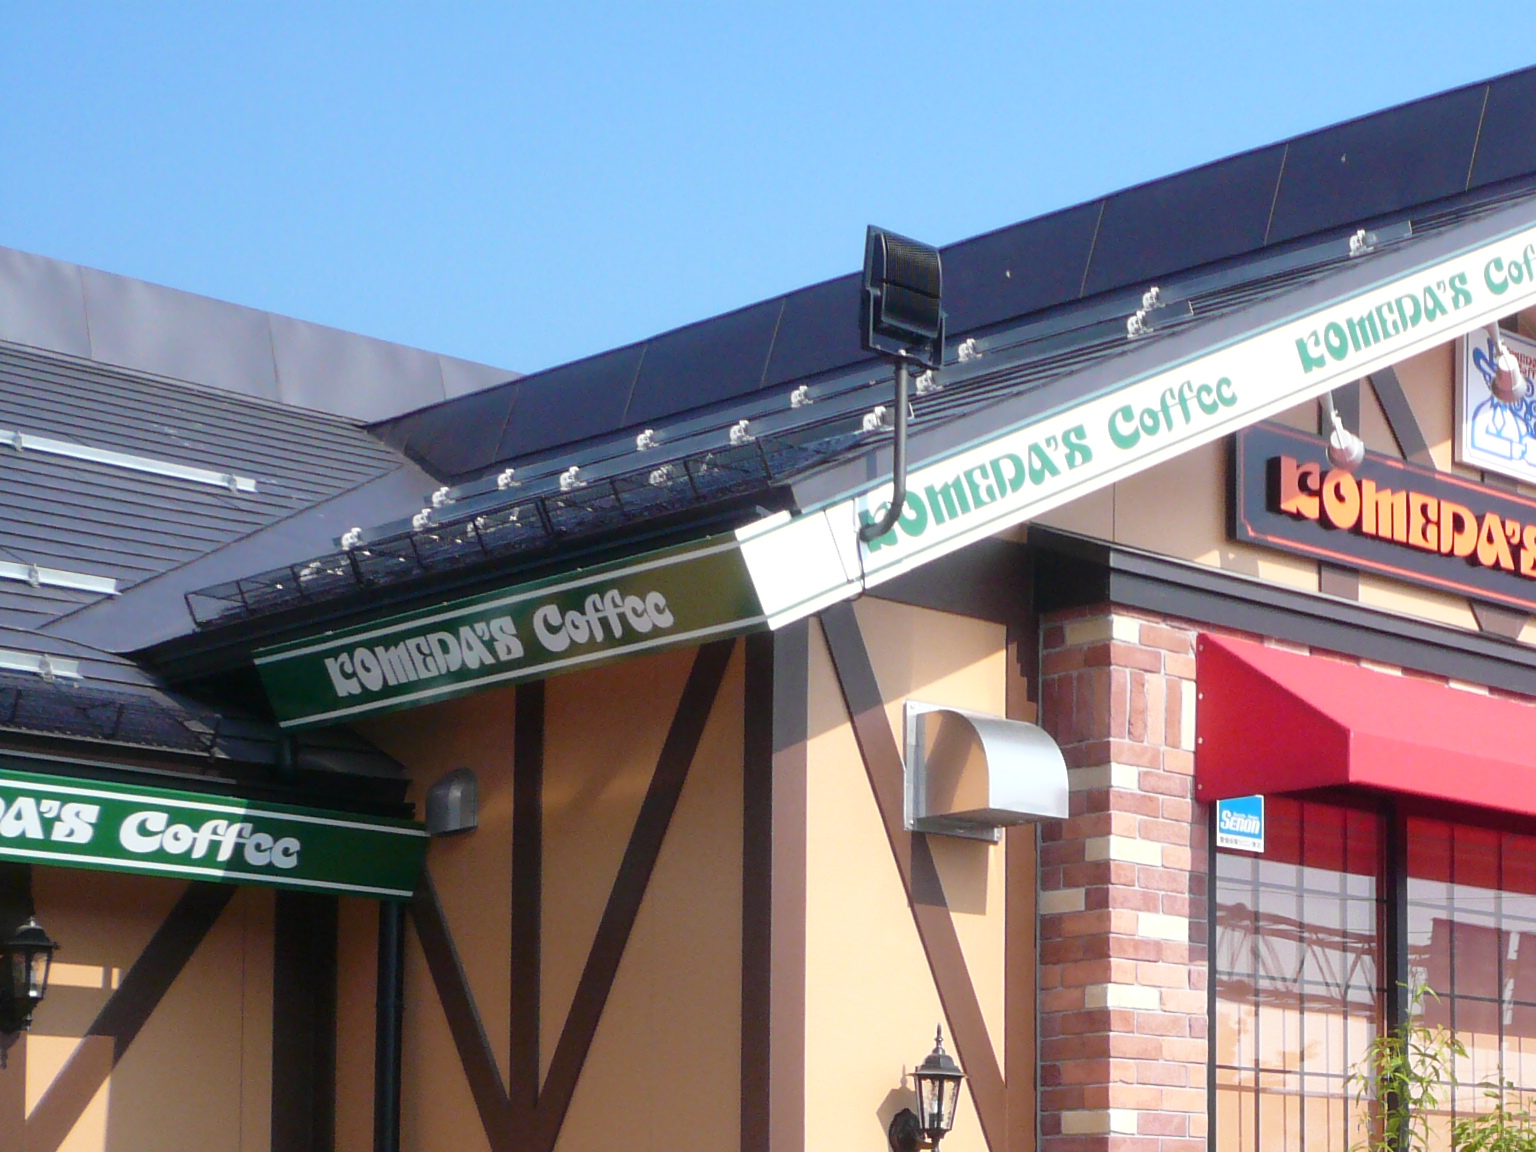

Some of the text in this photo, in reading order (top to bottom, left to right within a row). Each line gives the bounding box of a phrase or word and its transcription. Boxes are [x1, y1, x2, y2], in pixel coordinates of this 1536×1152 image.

[1295, 271, 1473, 374] KOMEDA'S
[1108, 377, 1238, 450] Coffee
[324, 589, 674, 697] KOMEDA'S Coffee
[0, 796, 300, 868] A'S Coffee
